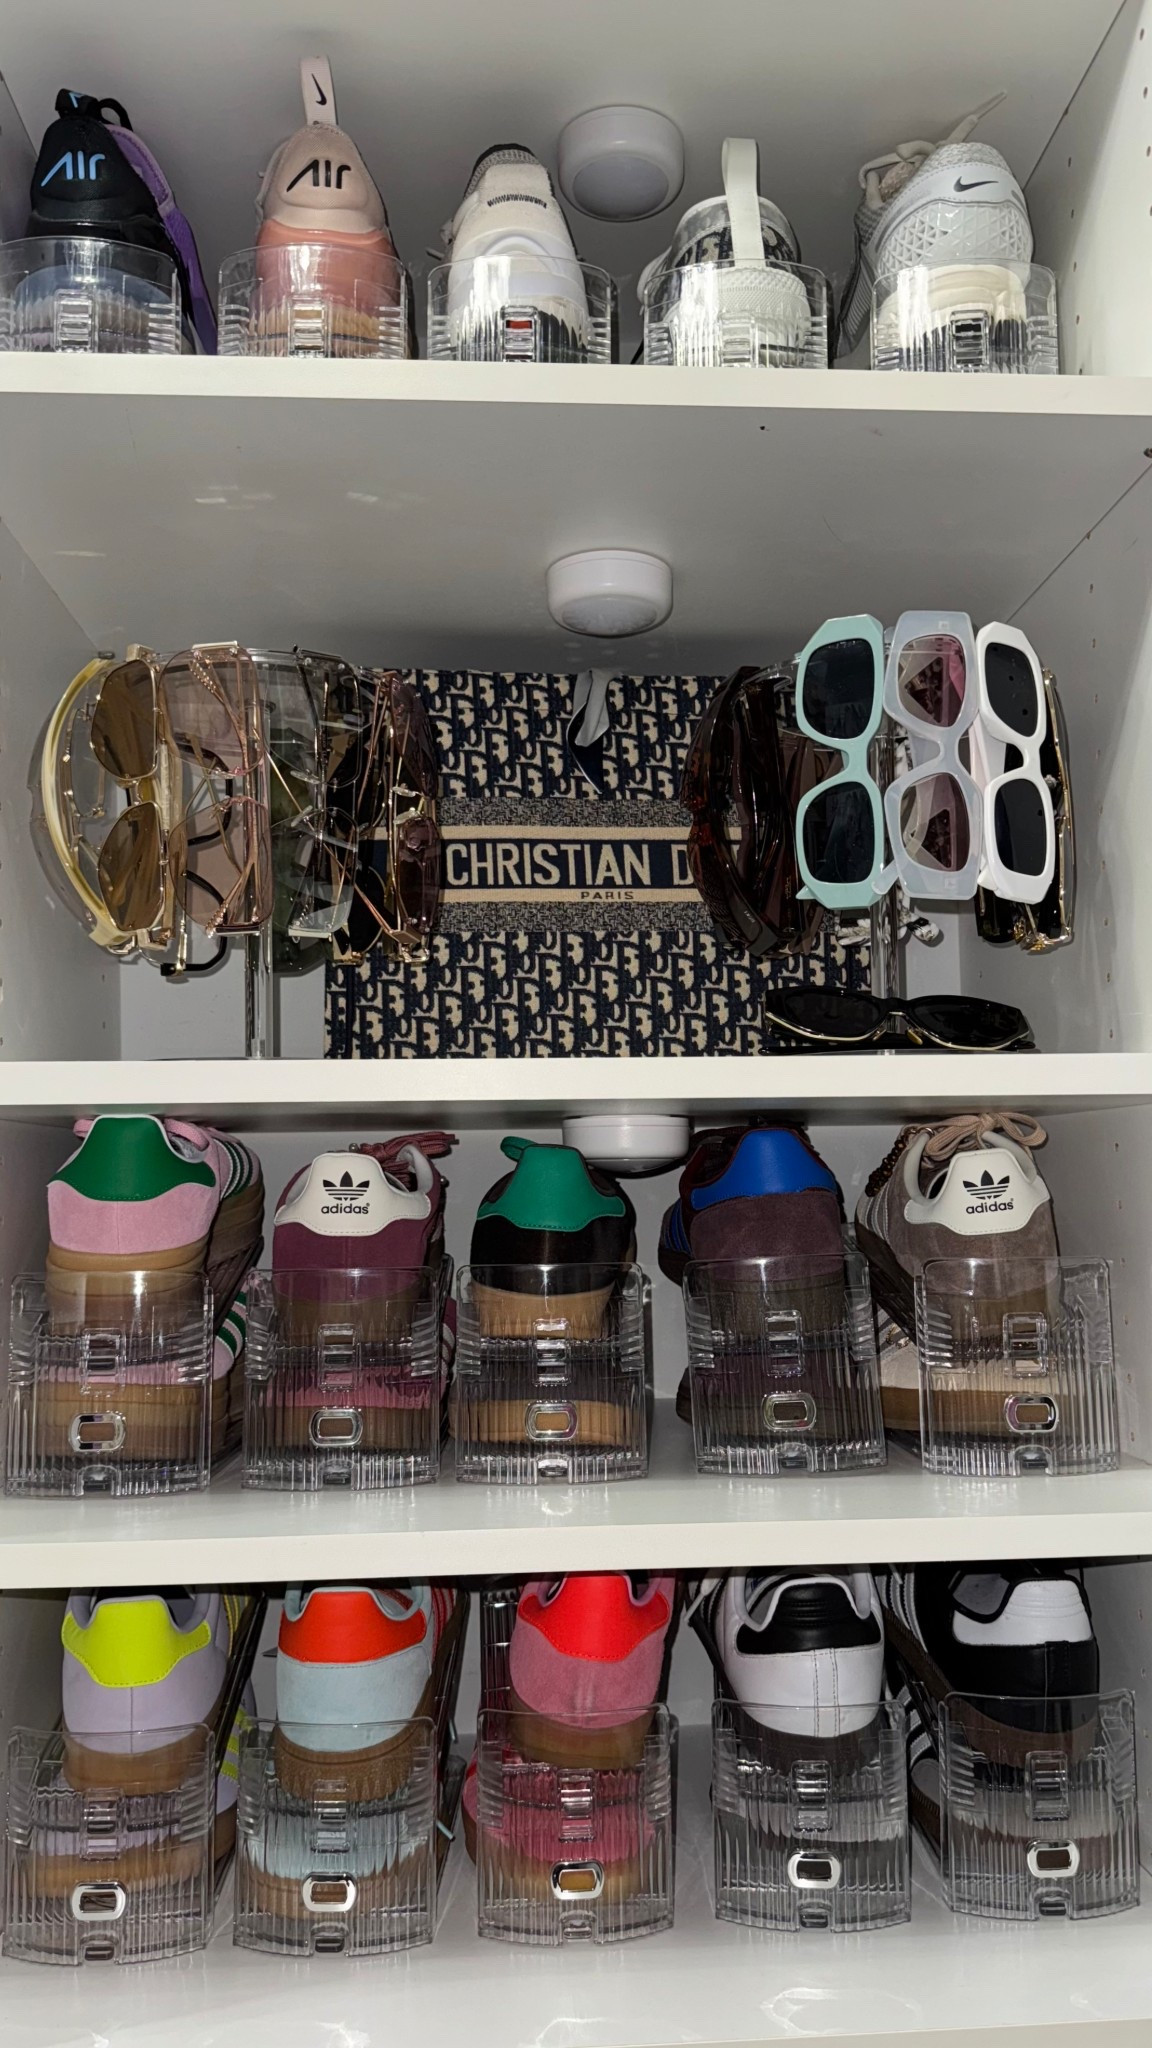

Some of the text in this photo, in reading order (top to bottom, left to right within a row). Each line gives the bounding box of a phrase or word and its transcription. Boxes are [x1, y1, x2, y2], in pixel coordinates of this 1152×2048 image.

[445, 843, 652, 886] CHRISTIAN
[580, 891, 634, 900] PARIS
[965, 1201, 1014, 1215] adidas
